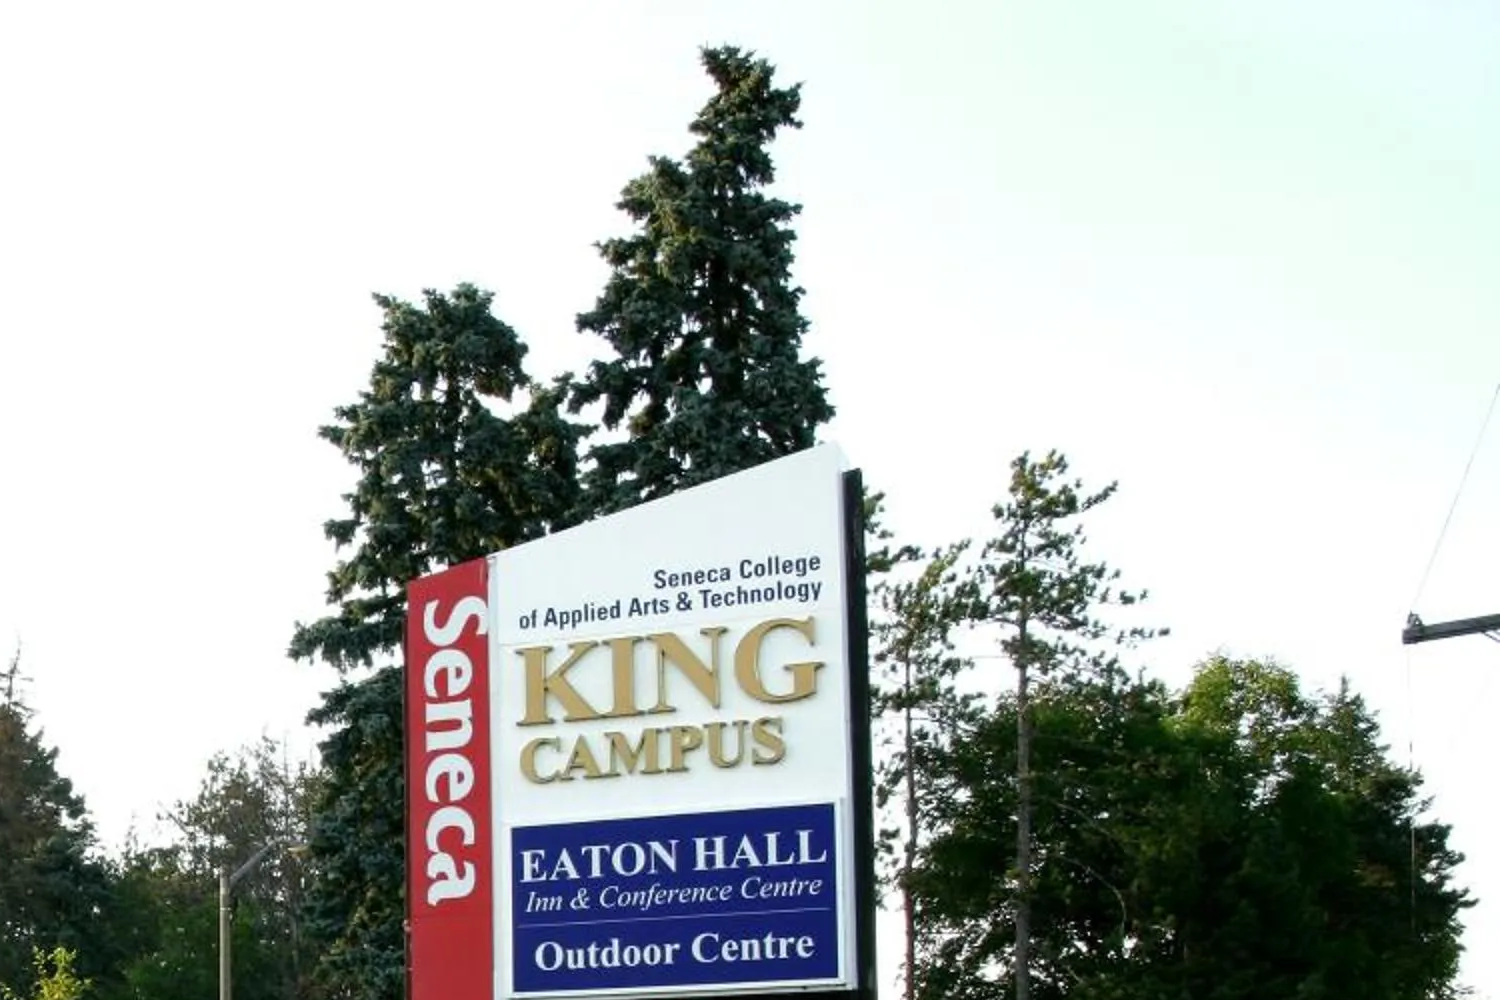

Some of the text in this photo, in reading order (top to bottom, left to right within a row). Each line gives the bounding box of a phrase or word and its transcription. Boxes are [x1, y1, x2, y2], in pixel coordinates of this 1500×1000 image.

[653, 554, 821, 590] Seneca College
[519, 581, 822, 629] of Applied Arts & Technology
[516, 616, 826, 727] KING
[423, 595, 489, 906] Seneca
[520, 717, 787, 784] CAMPUS
[520, 830, 827, 883] EATON HALL
[525, 876, 822, 913] Inn & Conference Centre
[535, 932, 815, 971] Outdoor Centre
